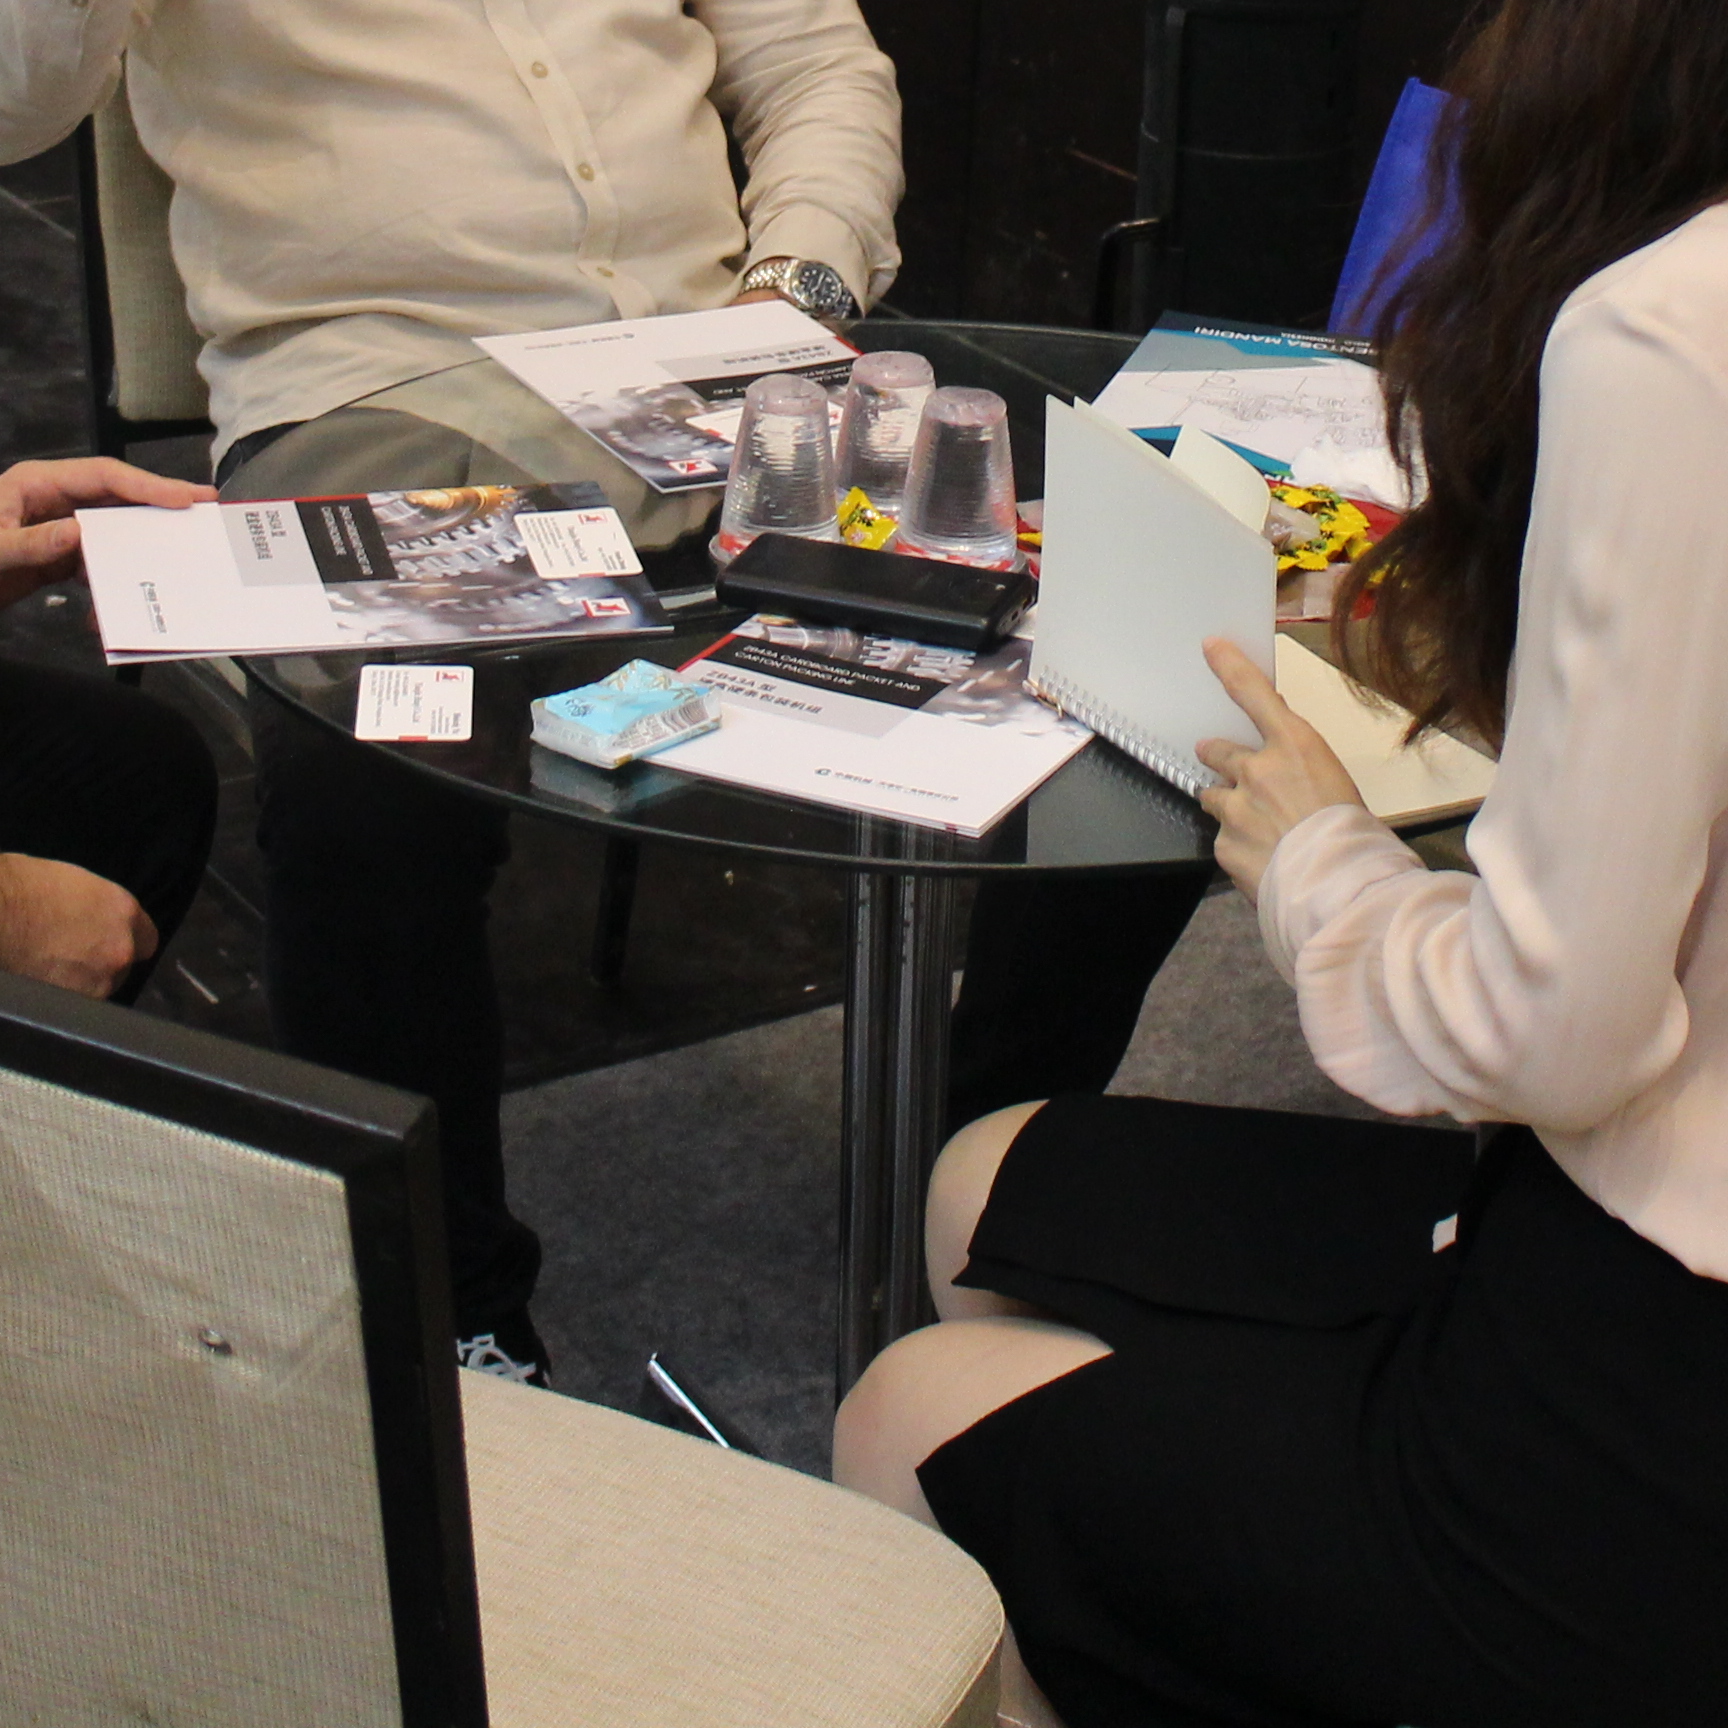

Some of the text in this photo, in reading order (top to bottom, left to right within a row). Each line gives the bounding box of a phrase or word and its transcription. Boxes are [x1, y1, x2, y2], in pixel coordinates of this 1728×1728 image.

[1194, 326, 1282, 345] MANDIRI
[735, 651, 782, 668] CARTON
[781, 654, 850, 676] CARDBOARD
